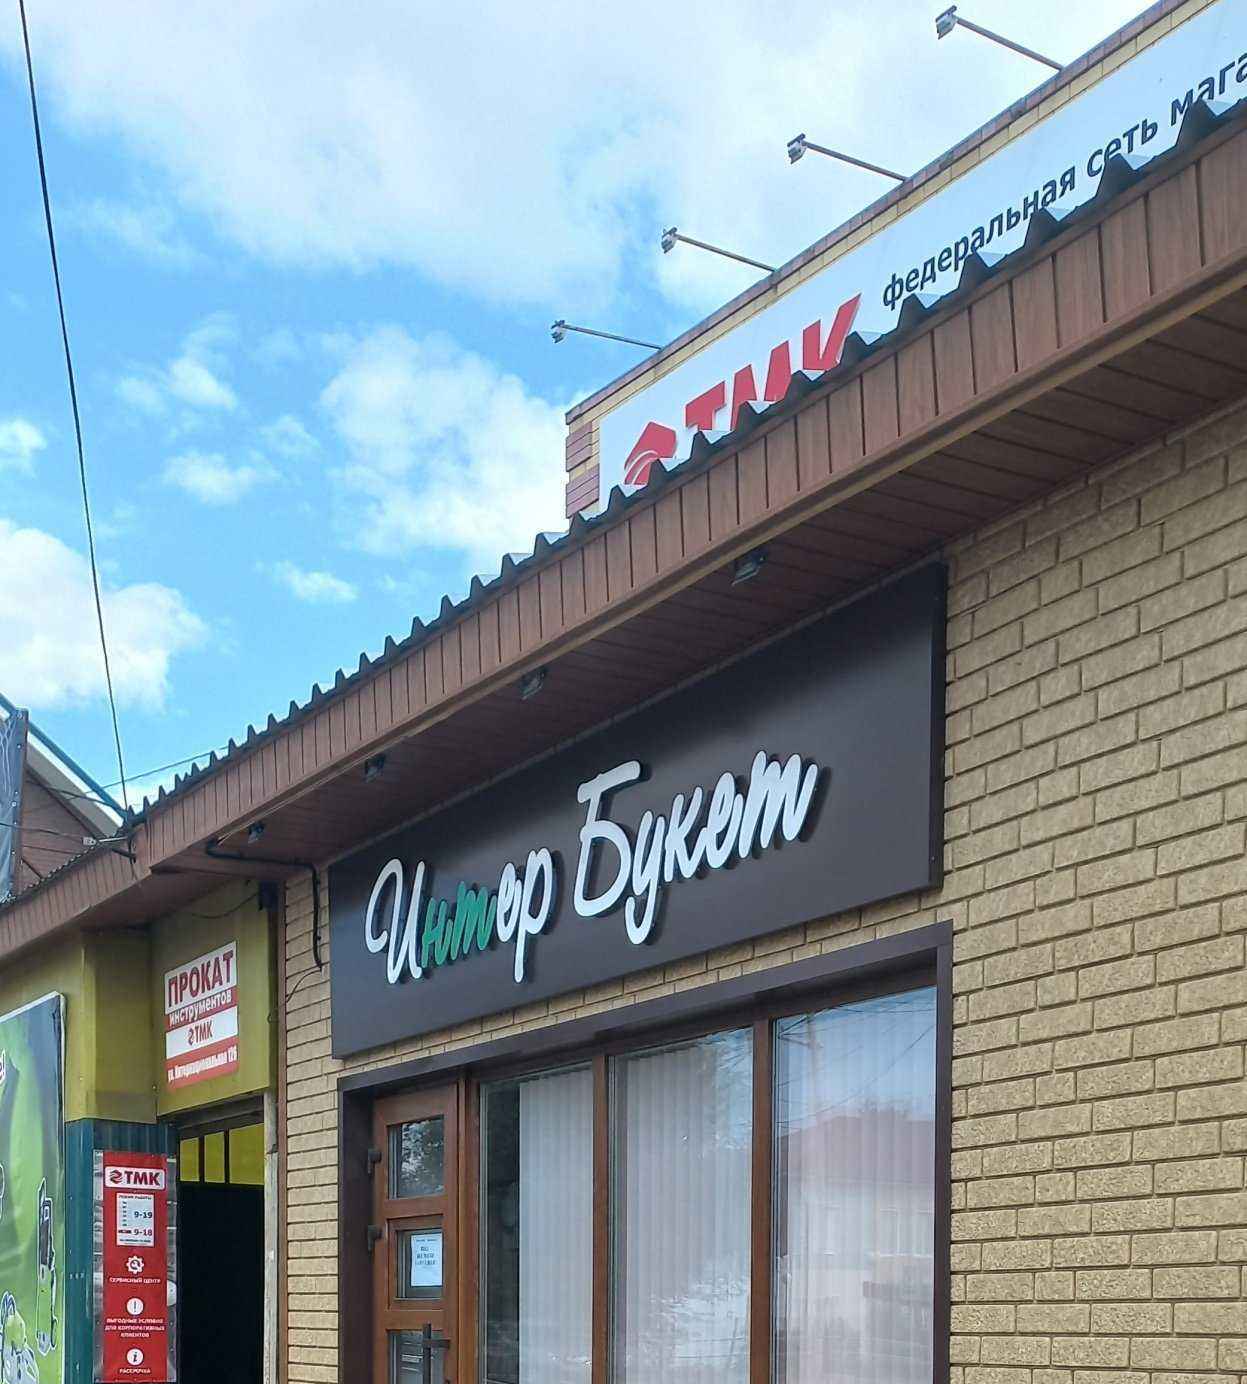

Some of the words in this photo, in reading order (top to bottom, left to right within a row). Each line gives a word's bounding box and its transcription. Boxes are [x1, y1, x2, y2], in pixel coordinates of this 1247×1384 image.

[883, 166, 1076, 311] федеральная
[1087, 119, 1159, 178] сеть
[365, 847, 555, 984] Интер
[573, 750, 819, 945] Букет
[168, 950, 234, 1007] ПРОКАТ
[169, 990, 232, 1027] инструментов
[195, 1020, 213, 1043] ТМК
[124, 1171, 160, 1186] ТМК
[134, 1211, 153, 1219] 9-19
[133, 1229, 153, 1237] 9-18
